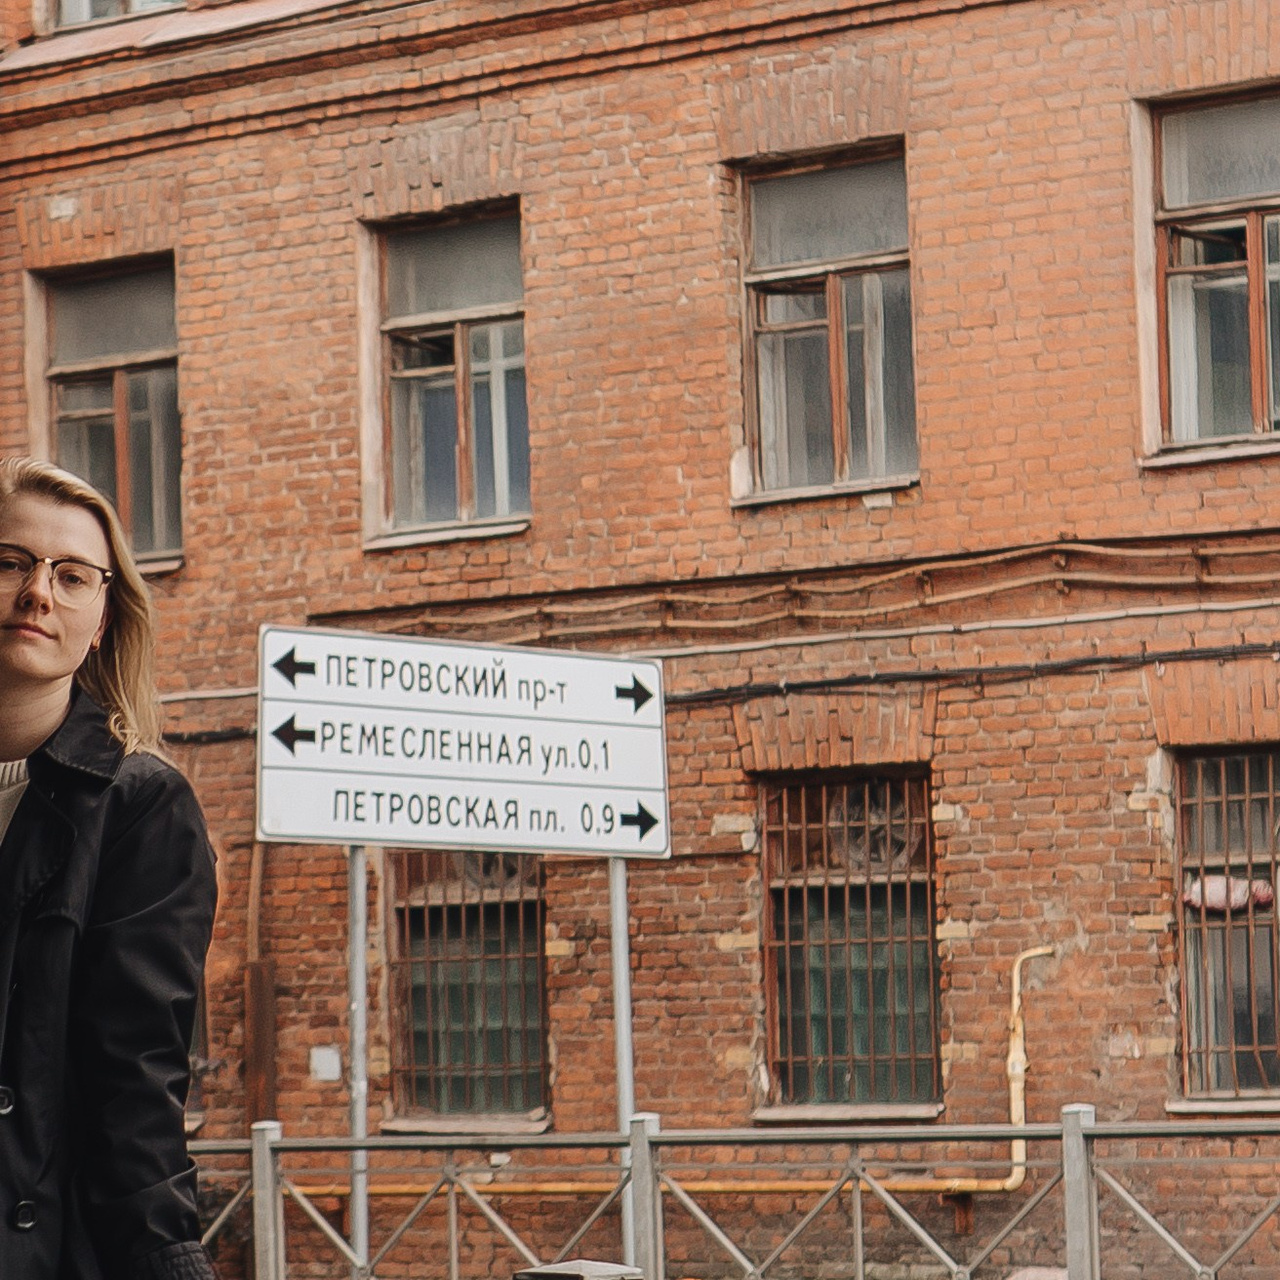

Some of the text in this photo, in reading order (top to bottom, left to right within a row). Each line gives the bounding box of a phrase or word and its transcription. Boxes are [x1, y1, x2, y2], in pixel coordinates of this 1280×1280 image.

[326, 654, 568, 710] ПЕТРОВСКИЙ пр-т
[320, 721, 533, 766] РЕМЕСЛЕННАЯ
[333, 789, 519, 831] ПЕТРОВСКАЯ
[529, 808, 566, 833] пл.
